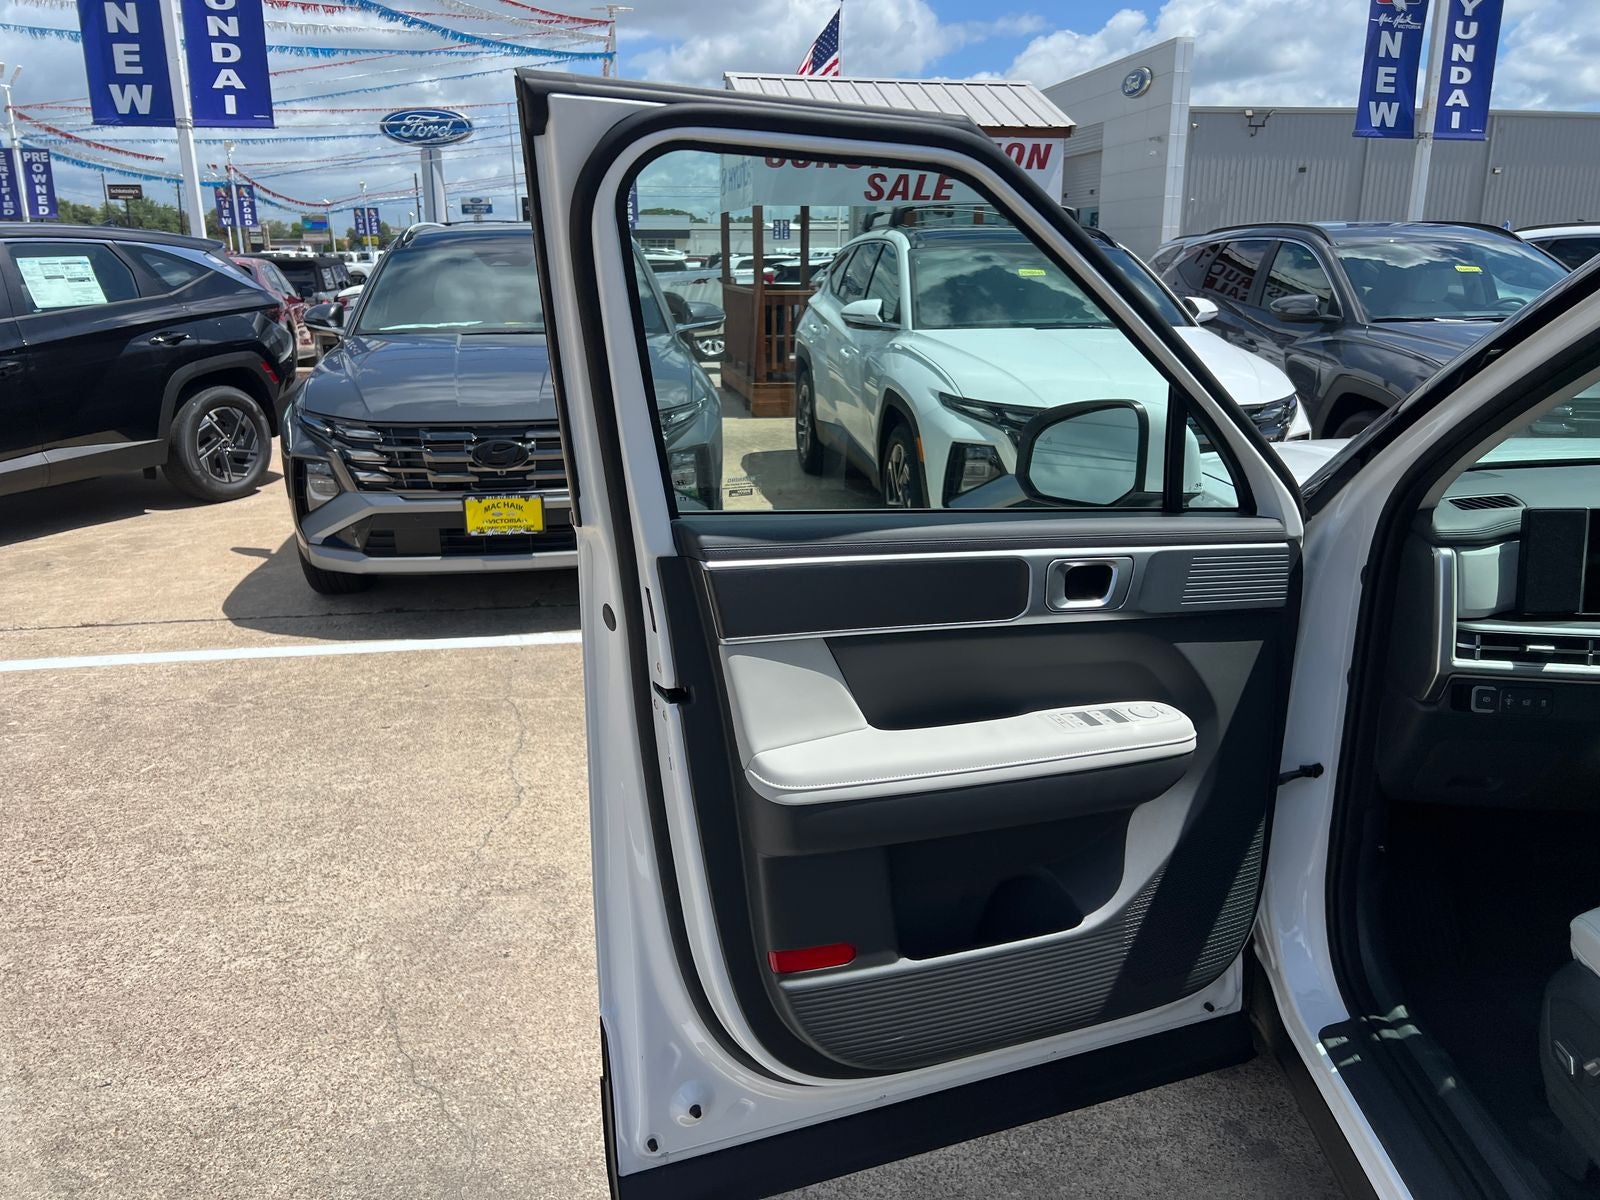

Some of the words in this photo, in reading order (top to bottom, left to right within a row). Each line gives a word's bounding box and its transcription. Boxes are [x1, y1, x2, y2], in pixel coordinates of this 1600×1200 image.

[104, 2, 152, 115] NEW
[1369, 30, 1403, 128] NEW
[400, 114, 454, 138] Ford
[22, 151, 49, 162] PRE
[31, 163, 49, 216] OWNED
[864, 173, 953, 202] SALE
[220, 200, 232, 225] NEW
[243, 201, 253, 226] FORD
[484, 502, 501, 513] MAC
